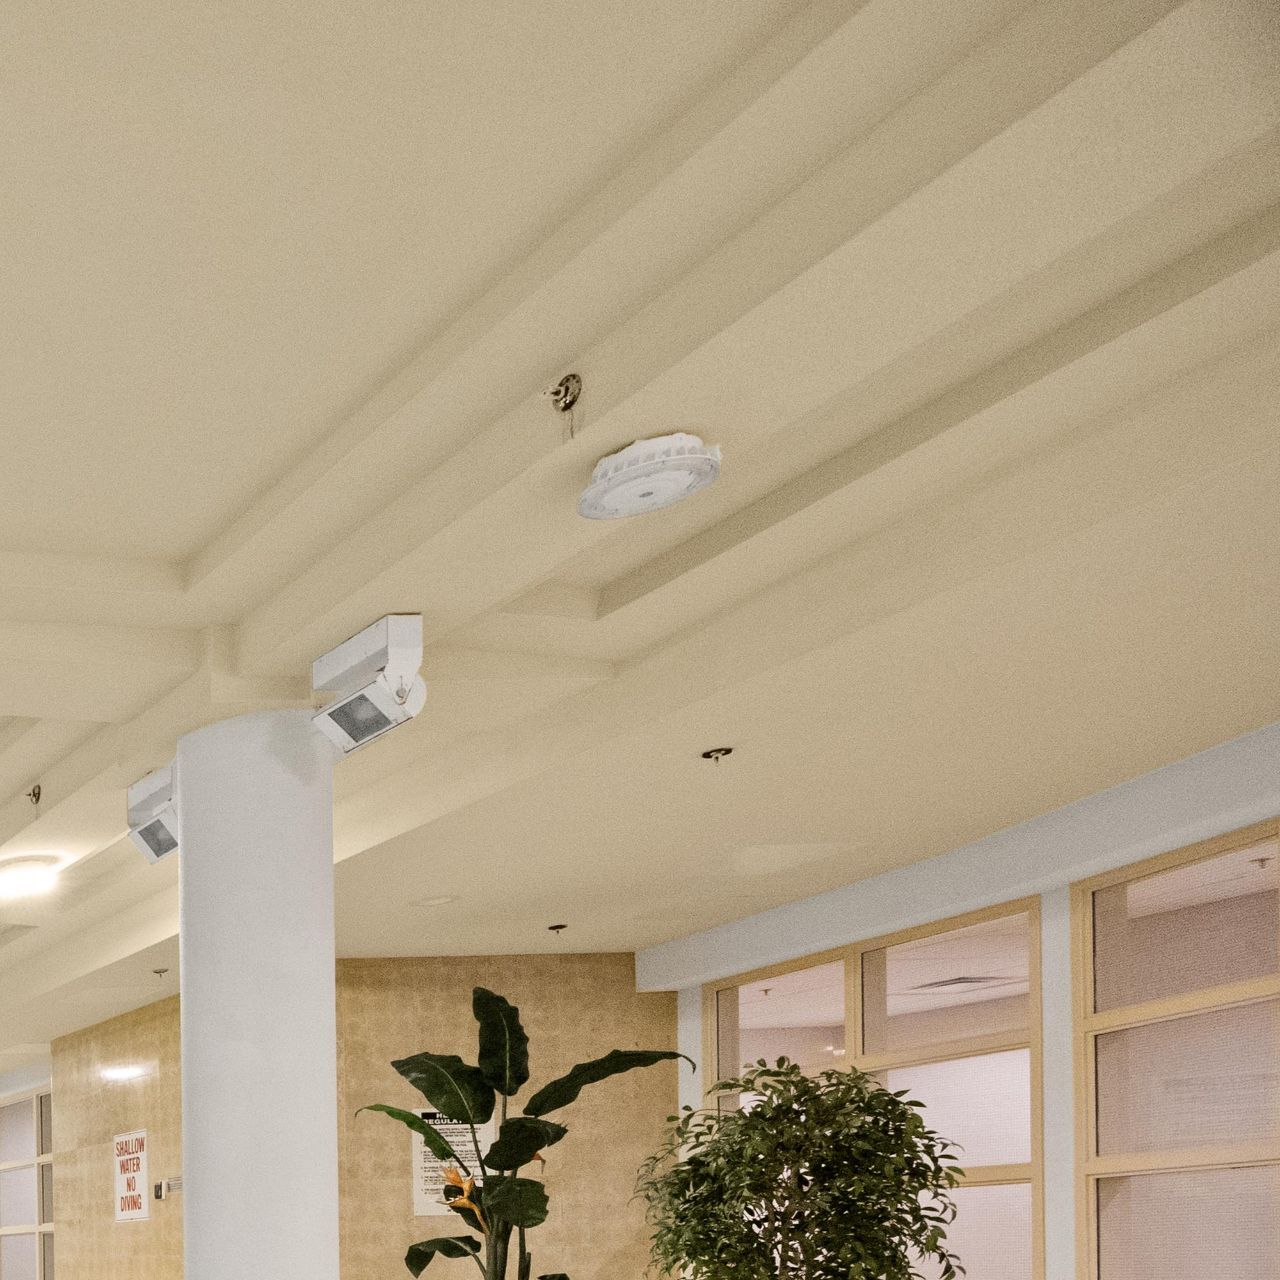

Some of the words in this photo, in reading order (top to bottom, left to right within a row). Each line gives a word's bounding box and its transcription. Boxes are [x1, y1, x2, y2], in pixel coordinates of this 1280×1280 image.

[115, 1137, 145, 1157] SHALLOW
[119, 1156, 141, 1175] WATER
[126, 1176, 136, 1192] NO
[120, 1194, 142, 1212] DIVING
